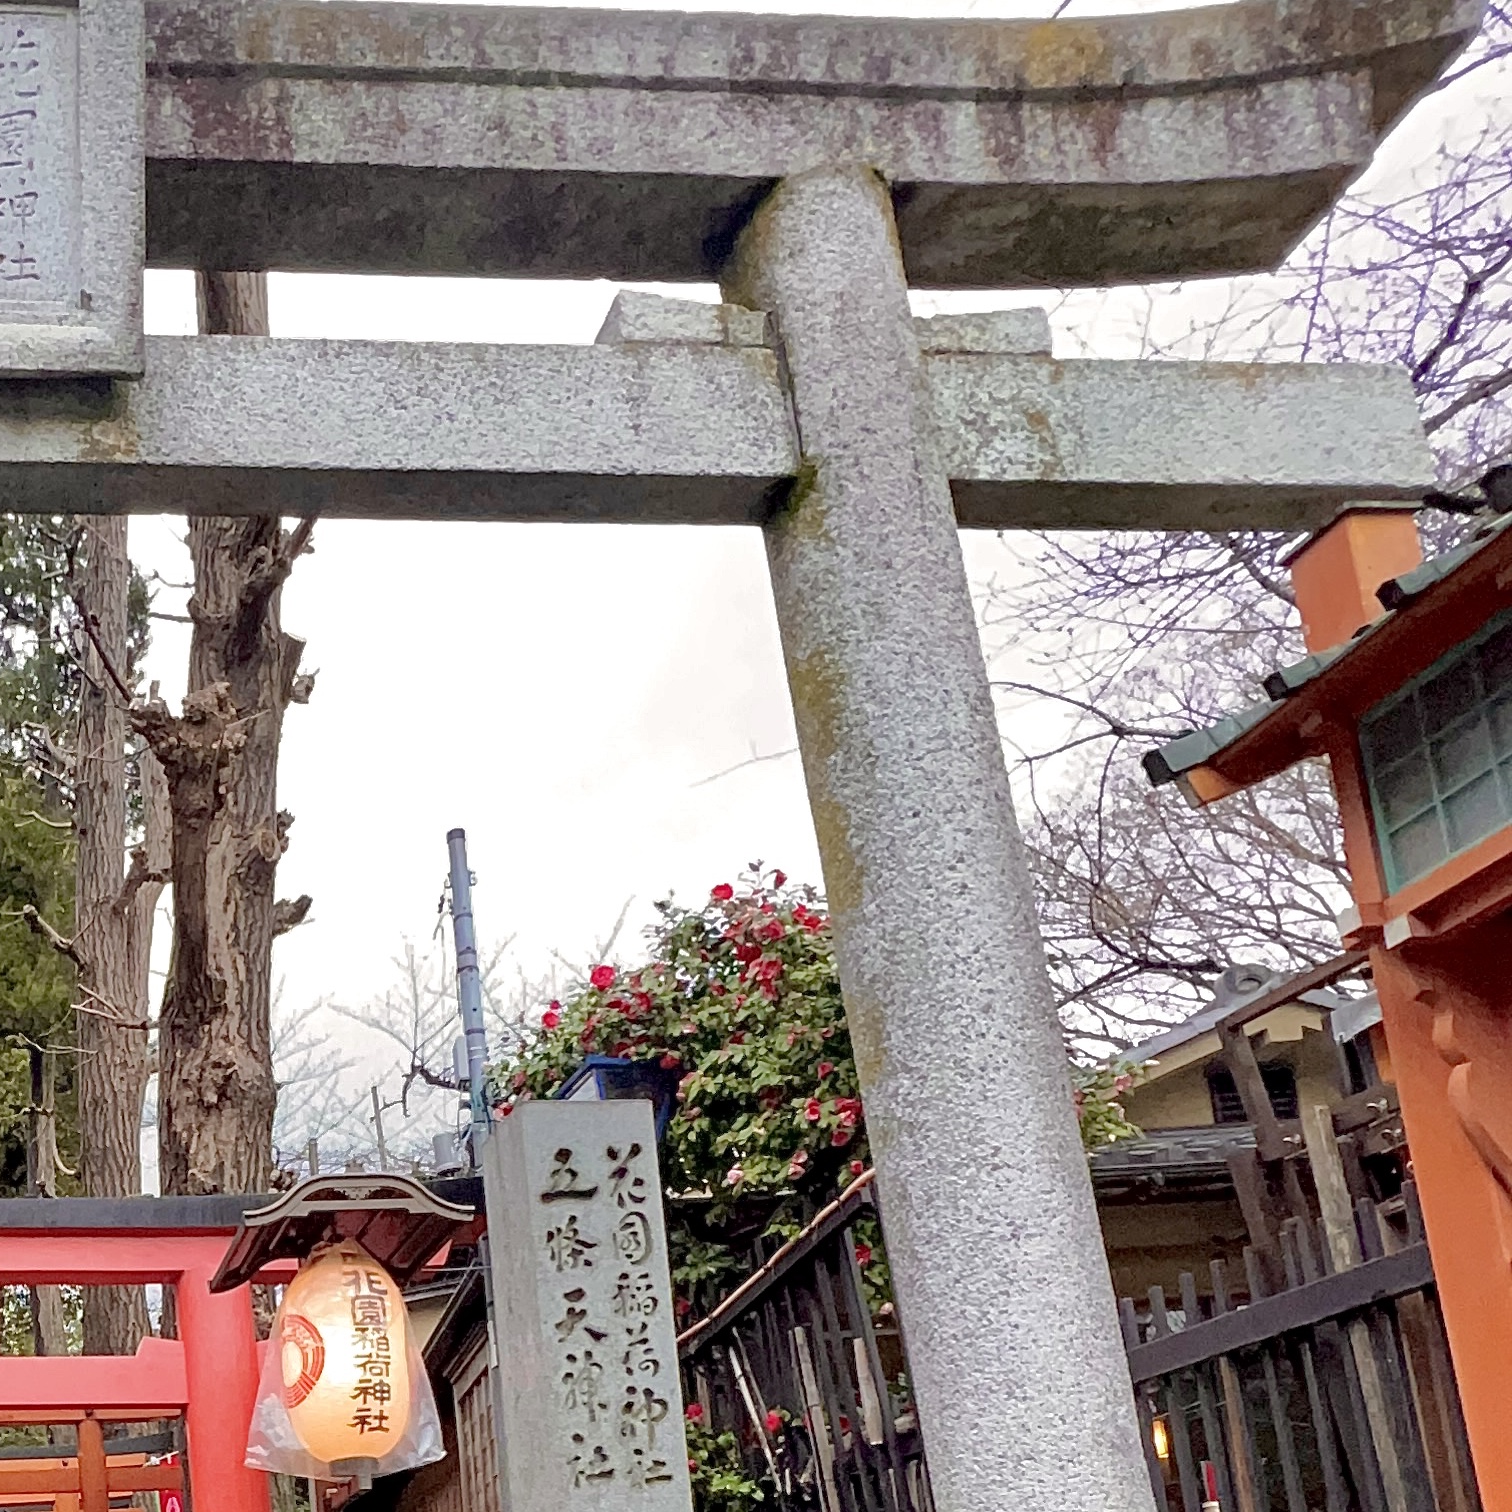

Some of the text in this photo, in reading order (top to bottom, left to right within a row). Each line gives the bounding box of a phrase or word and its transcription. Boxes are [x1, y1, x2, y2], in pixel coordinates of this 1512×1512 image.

[343, 1269, 393, 1436] 花園稲荷神社
